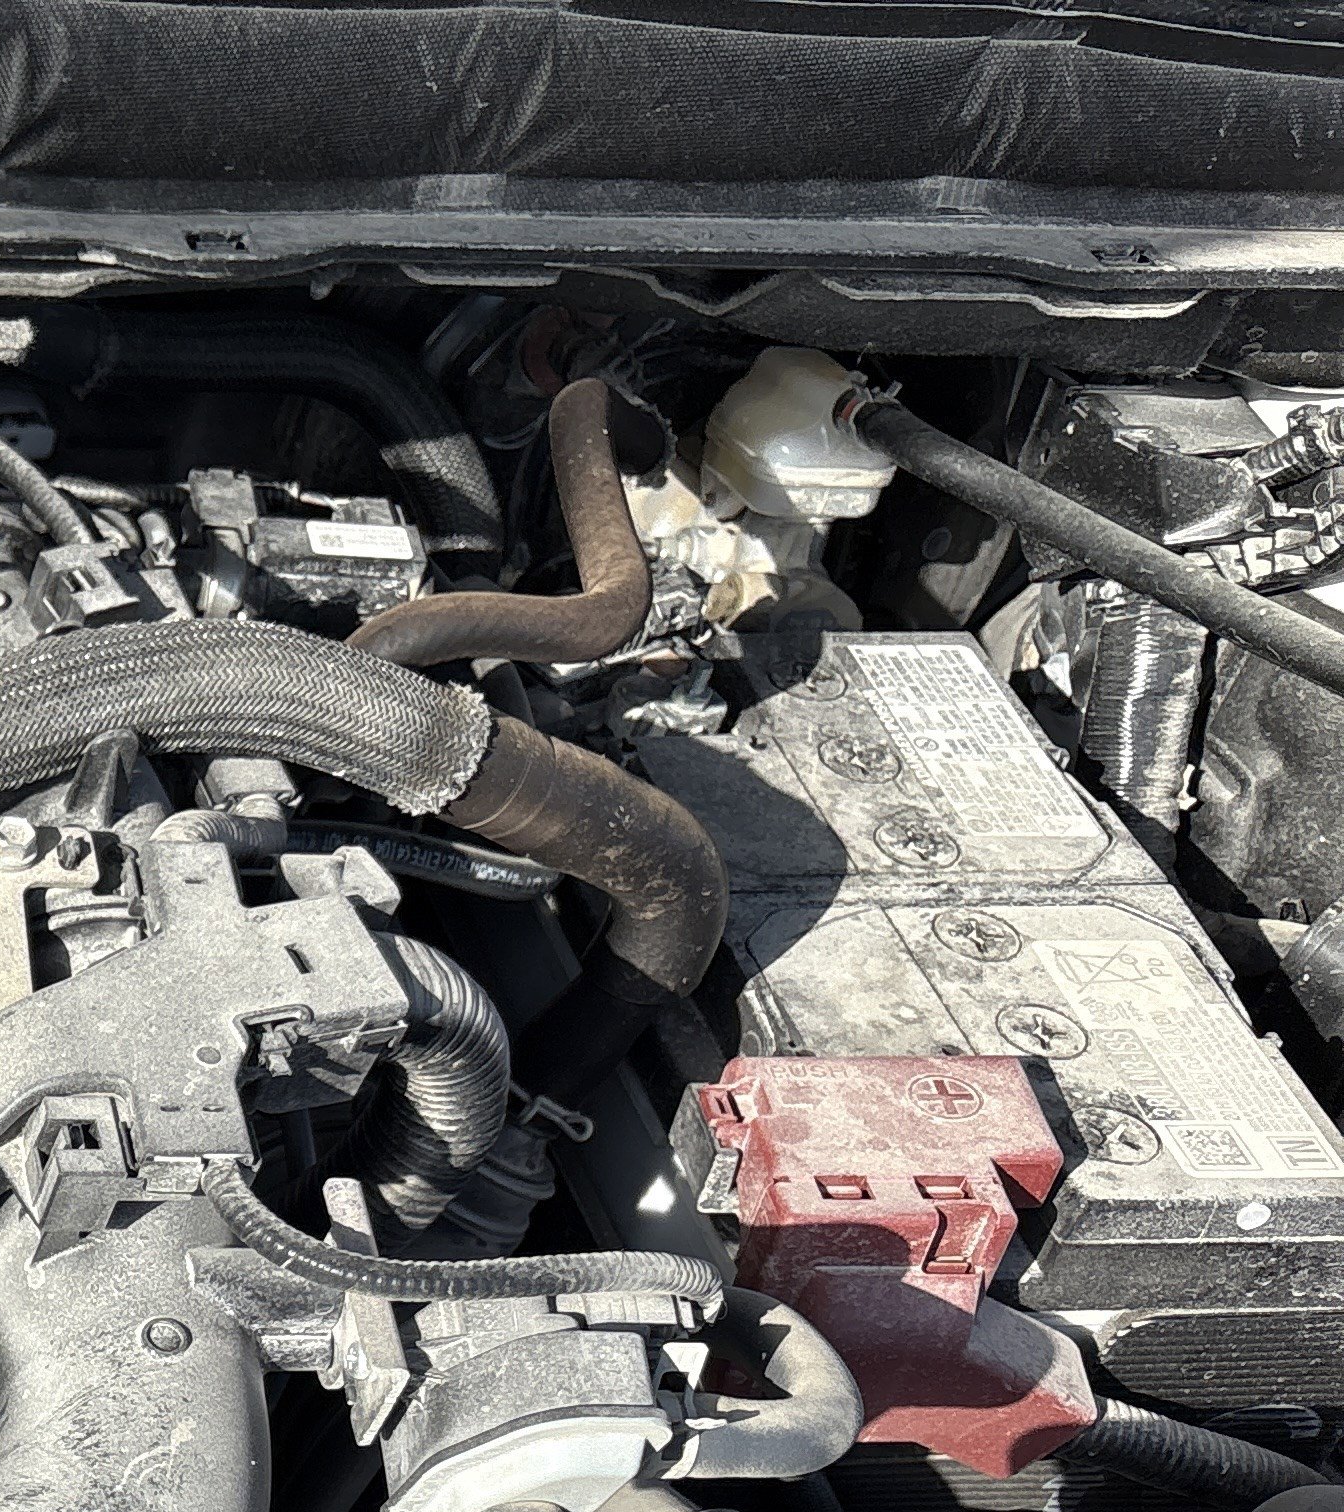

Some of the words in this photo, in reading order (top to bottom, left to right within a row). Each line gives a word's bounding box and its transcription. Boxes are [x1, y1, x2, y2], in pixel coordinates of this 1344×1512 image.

[1146, 957, 1172, 979] Pb
[769, 1065, 848, 1079] PUSH
[1278, 1138, 1329, 1167] TN
